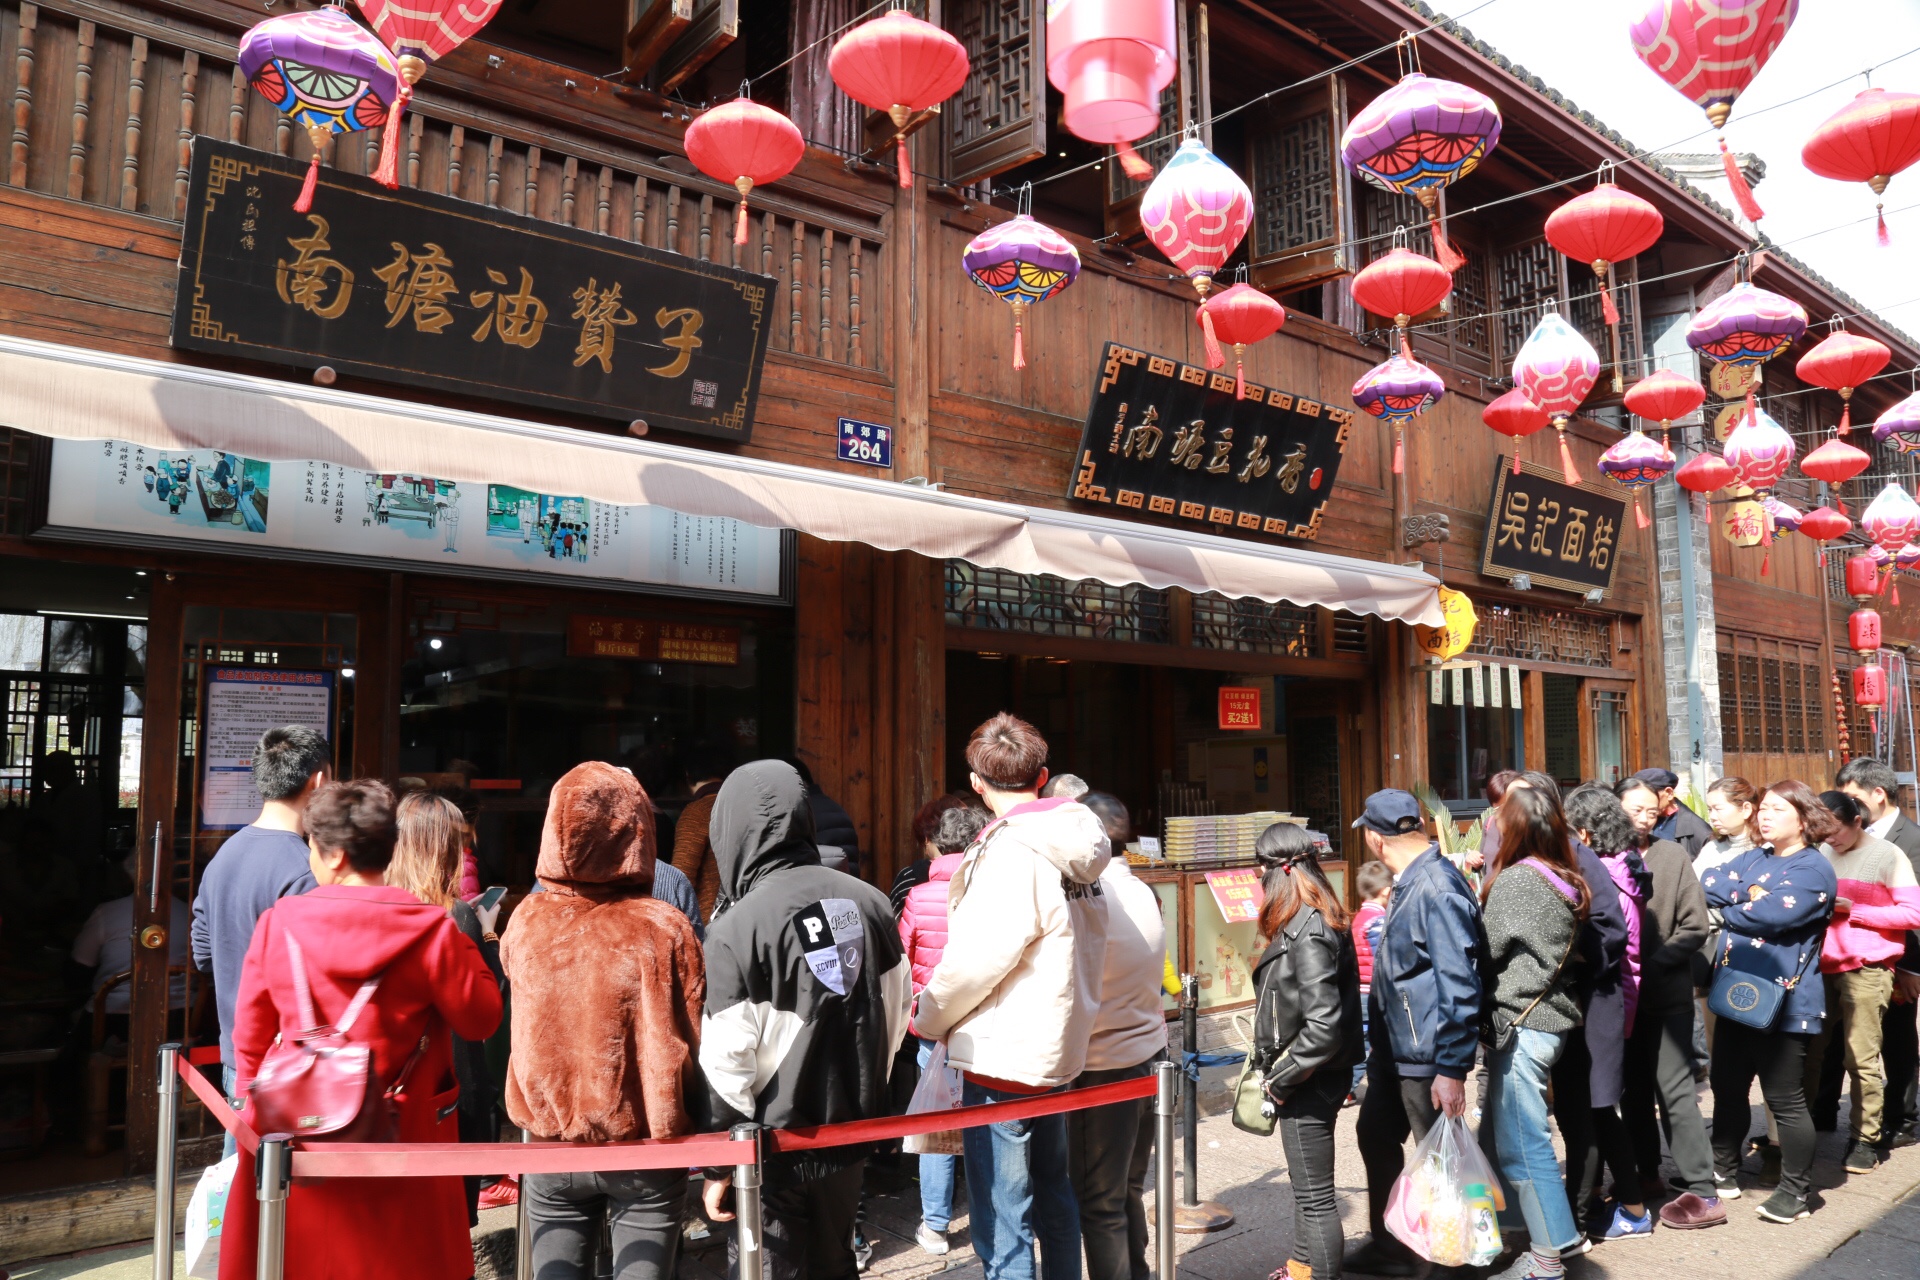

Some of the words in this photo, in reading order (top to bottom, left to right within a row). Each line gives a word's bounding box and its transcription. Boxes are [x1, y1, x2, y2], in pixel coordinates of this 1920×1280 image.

[844, 423, 886, 441] 南郊路
[848, 439, 881, 462] 264
[217, 670, 322, 684] 食品添加剂安全使用公示栏
[1228, 712, 1253, 723] 买2送1
[803, 917, 823, 943] P
